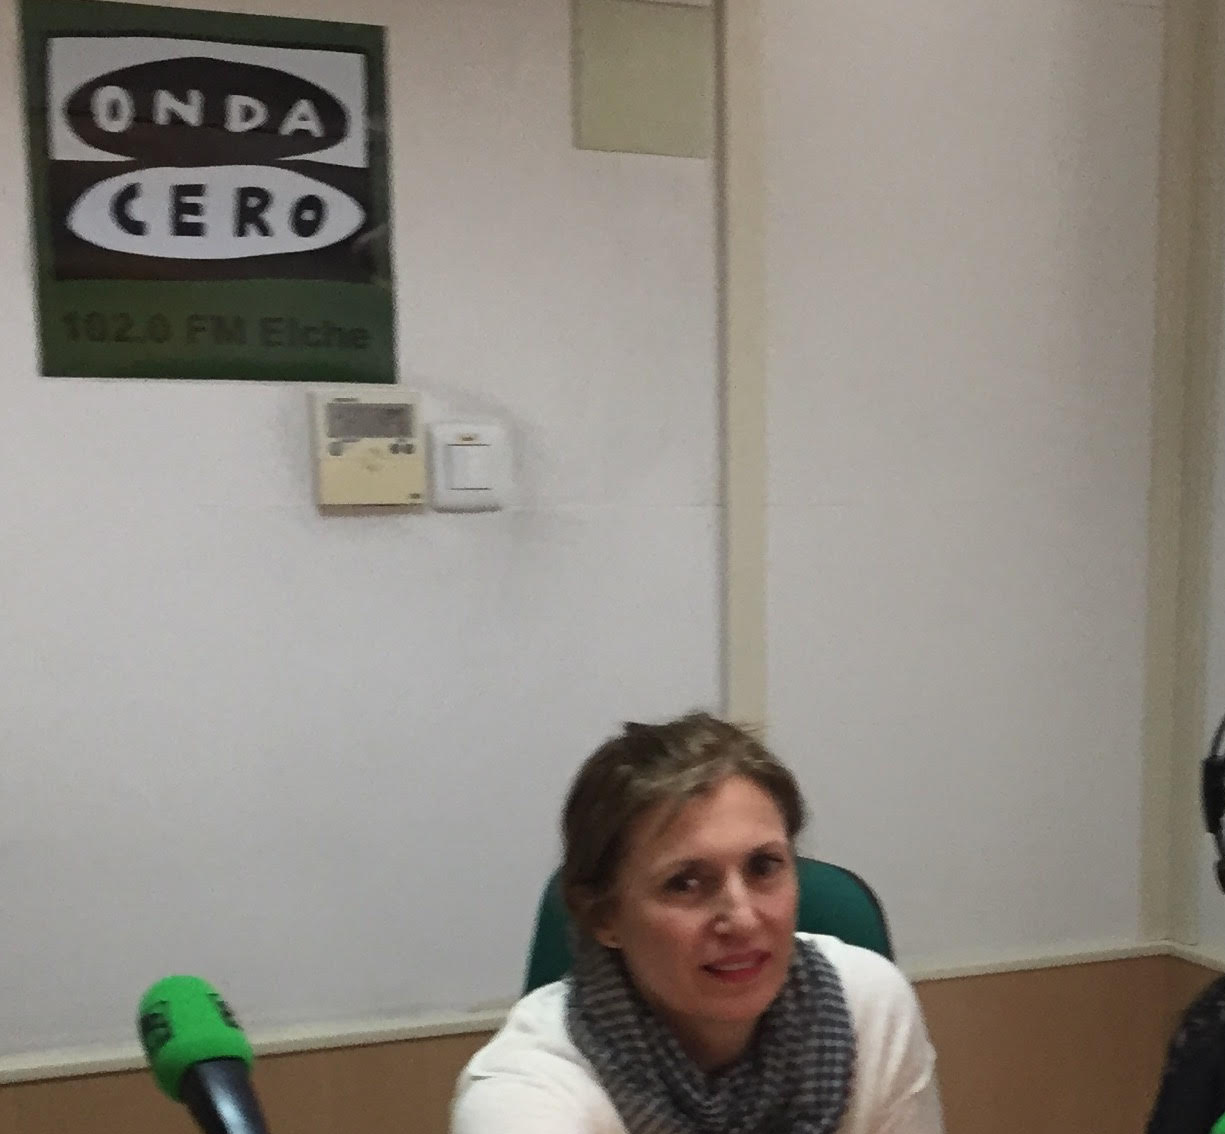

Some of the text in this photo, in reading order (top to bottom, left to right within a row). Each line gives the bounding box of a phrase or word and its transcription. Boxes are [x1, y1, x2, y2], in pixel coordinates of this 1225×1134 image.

[91, 85, 325, 137] ONDA
[110, 182, 329, 238] CERO
[186, 313, 248, 345] FM
[258, 316, 371, 350] Elche
